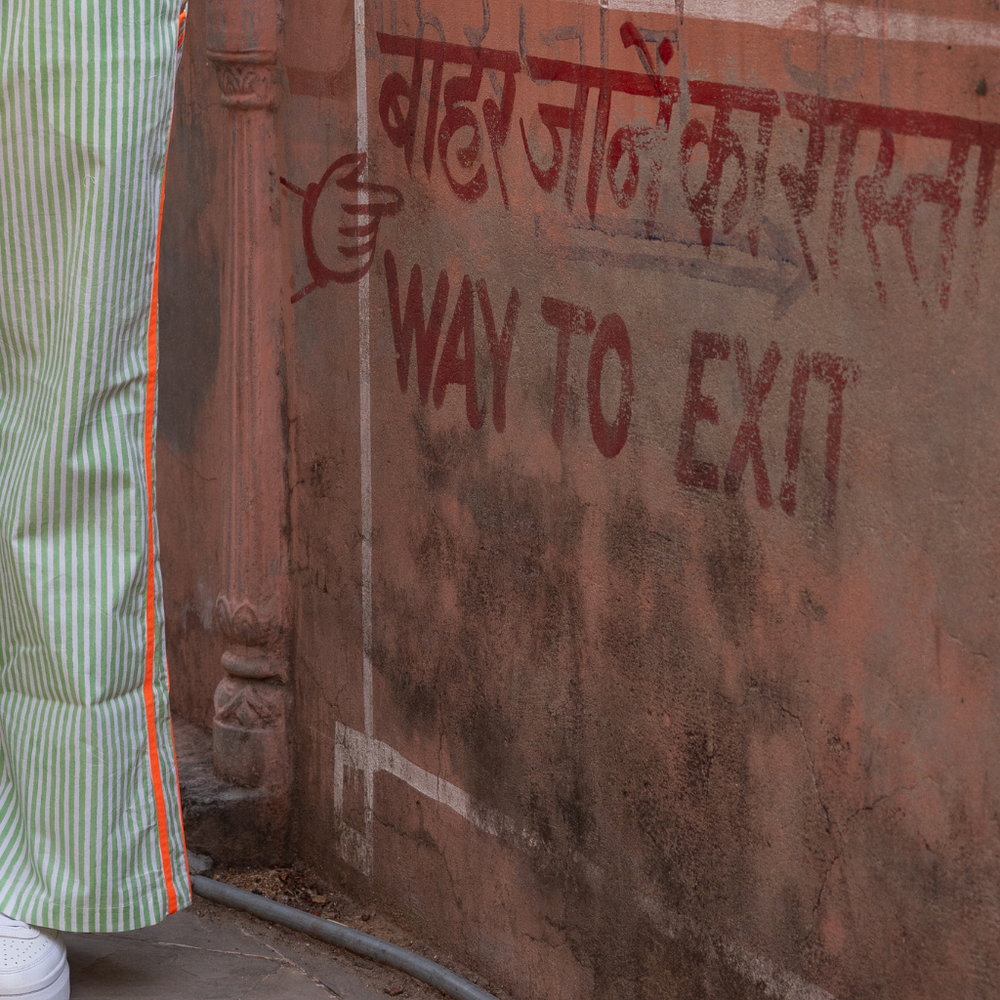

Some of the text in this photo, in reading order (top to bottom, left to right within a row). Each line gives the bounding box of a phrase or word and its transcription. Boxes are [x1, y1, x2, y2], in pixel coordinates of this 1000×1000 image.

[377, 31, 521, 211] बाहर
[677, 79, 781, 258] का
[384, 248, 862, 517] WAY TO EXIT
